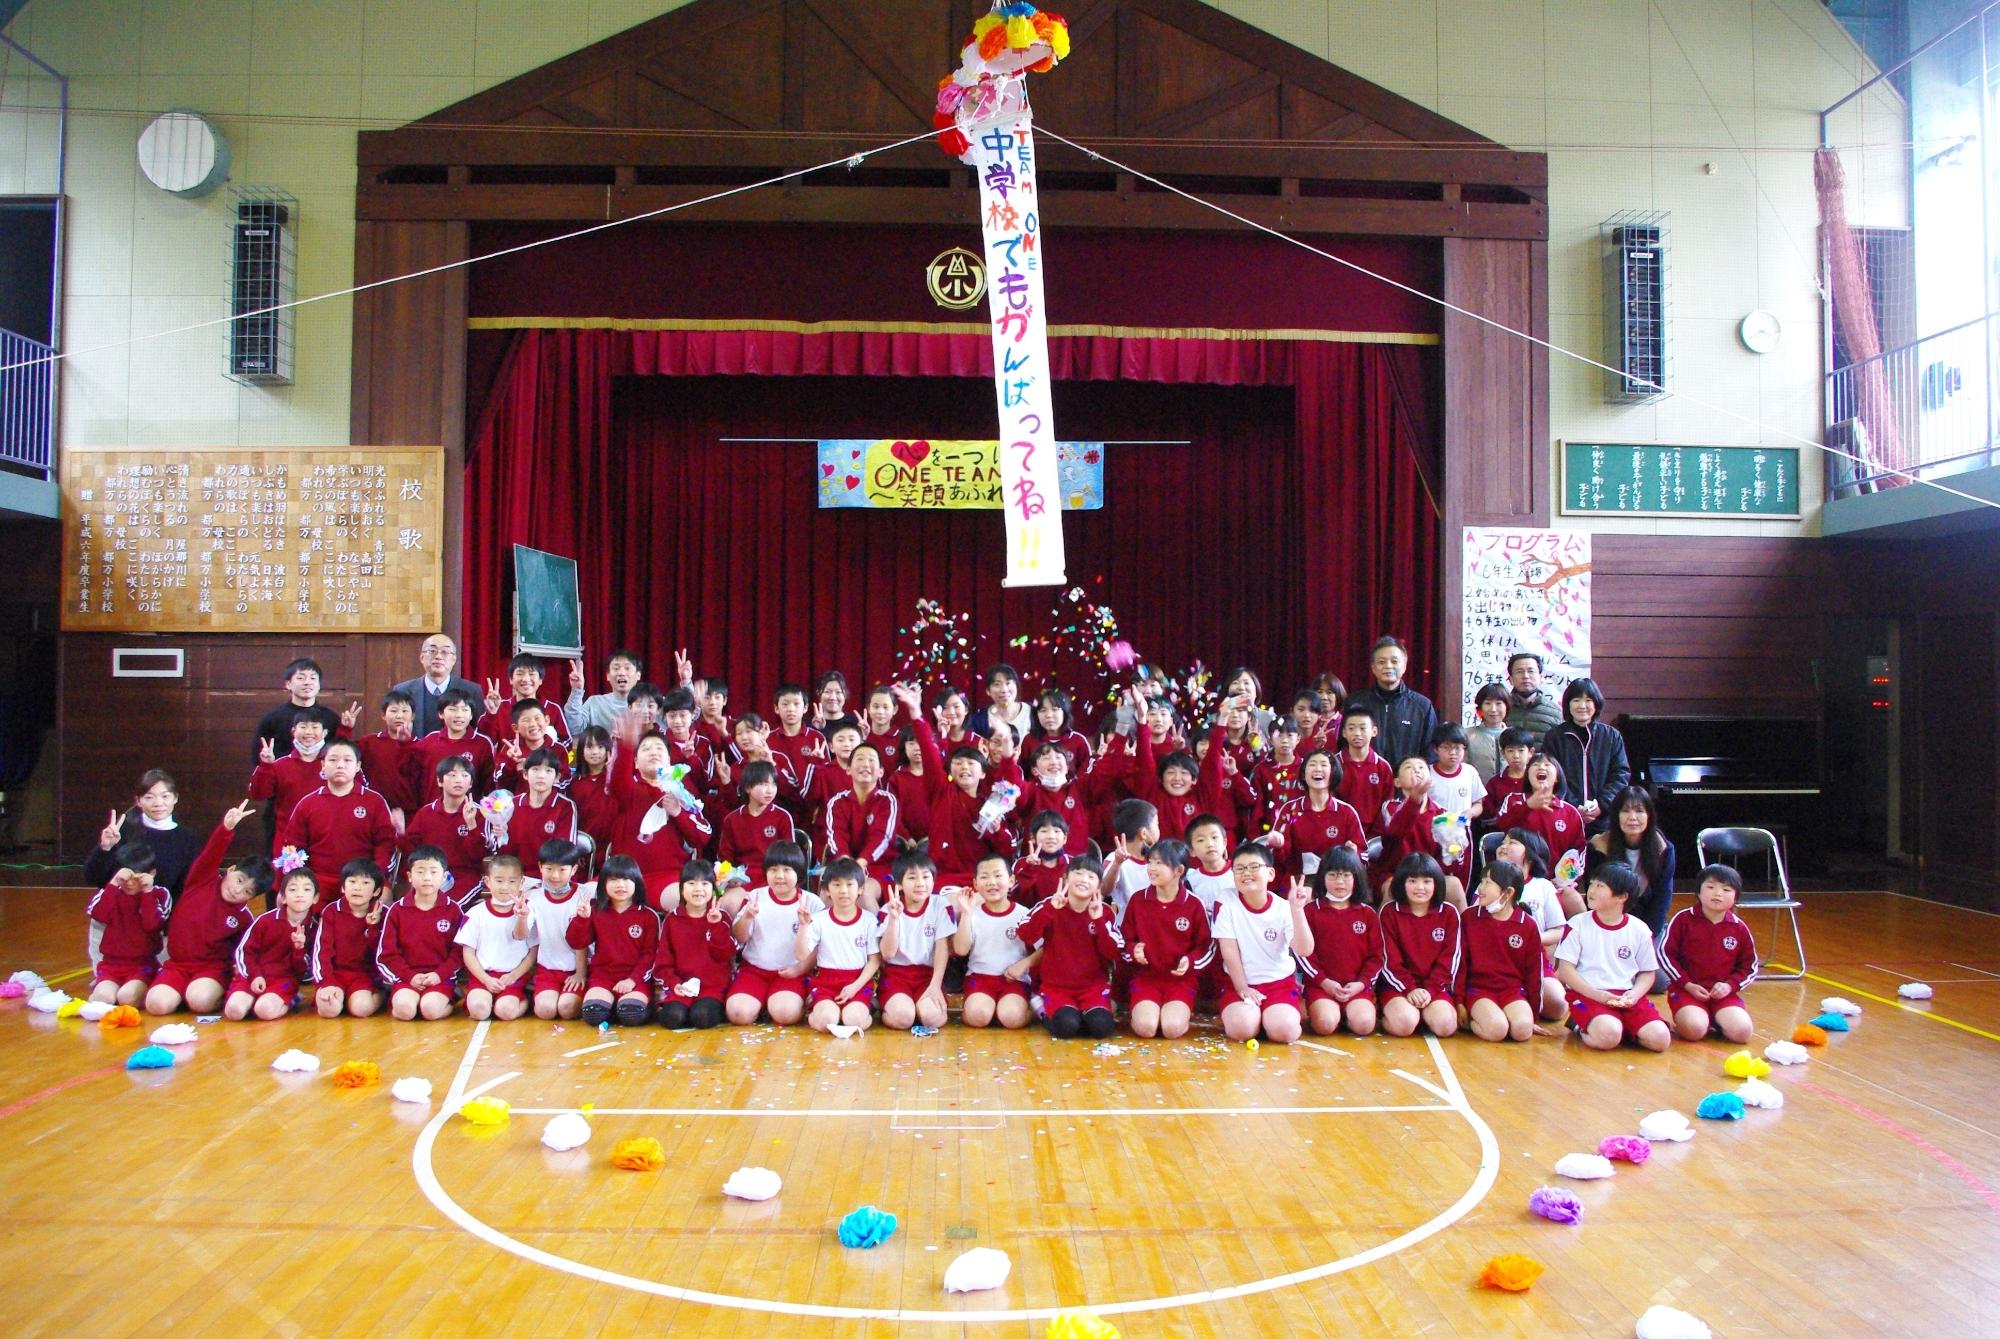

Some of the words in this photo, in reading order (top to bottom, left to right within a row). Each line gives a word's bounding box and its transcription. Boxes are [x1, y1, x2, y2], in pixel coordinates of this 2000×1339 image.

[1013, 130, 1032, 194] TEAM
[1023, 212, 1037, 271] ONE
[105, 477, 117, 500] 都万
[116, 465, 129, 513] われらの
[128, 465, 142, 526] 理想の花は
[153, 466, 165, 538] いつも楽しく
[176, 464, 190, 525] 清き流れの
[202, 477, 214, 500] 都万
[214, 466, 226, 513] われらの
[226, 465, 239, 513] 力の歌は
[237, 465, 251, 538] 通うぼくらの
[251, 466, 263, 538] いつも楽しく
[301, 478, 313, 500] 都万
[312, 466, 325, 513] われらの
[324, 466, 337, 525] 希望の風は
[336, 466, 349, 538] 学ぶぼくらの
[350, 466, 362, 538] いつも楽しく
[362, 466, 375, 538] 明るくあおぐ
[374, 466, 387, 526] 光あふれる
[874, 463, 931, 488] ONE
[103, 514, 116, 538] 都万
[201, 515, 213, 538] 都万
[263, 466, 275, 550] しぶきはおどる
[300, 515, 312, 538] 都万
[399, 478, 423, 550] 校歌
[79, 514, 93, 613] 平成六年度卒業生
[115, 528, 128, 550] 母校
[212, 528, 225, 550] 母校
[225, 528, 237, 588] ここにわく
[311, 528, 324, 550] 母校
[373, 540, 385, 576] 青空に
[1483, 534, 1581, 553] プログラム
[102, 552, 115, 613] 都万小学校
[126, 540, 139, 601] ここに咲く
[138, 552, 151, 613] わたしらの
[150, 552, 163, 613] ほがらかに
[200, 552, 212, 613] 都万小学校
[236, 552, 249, 613] わたしらの
[249, 552, 261, 600] 元気よく
[261, 565, 274, 600] 日本海
[273, 564, 286, 600] 波白く
[298, 552, 311, 613] 都万小学校
[323, 541, 336, 601] ここに吹く
[336, 552, 349, 613] わたしらの
[348, 552, 360, 613] なごやかに
[360, 552, 372, 588] 高田山
